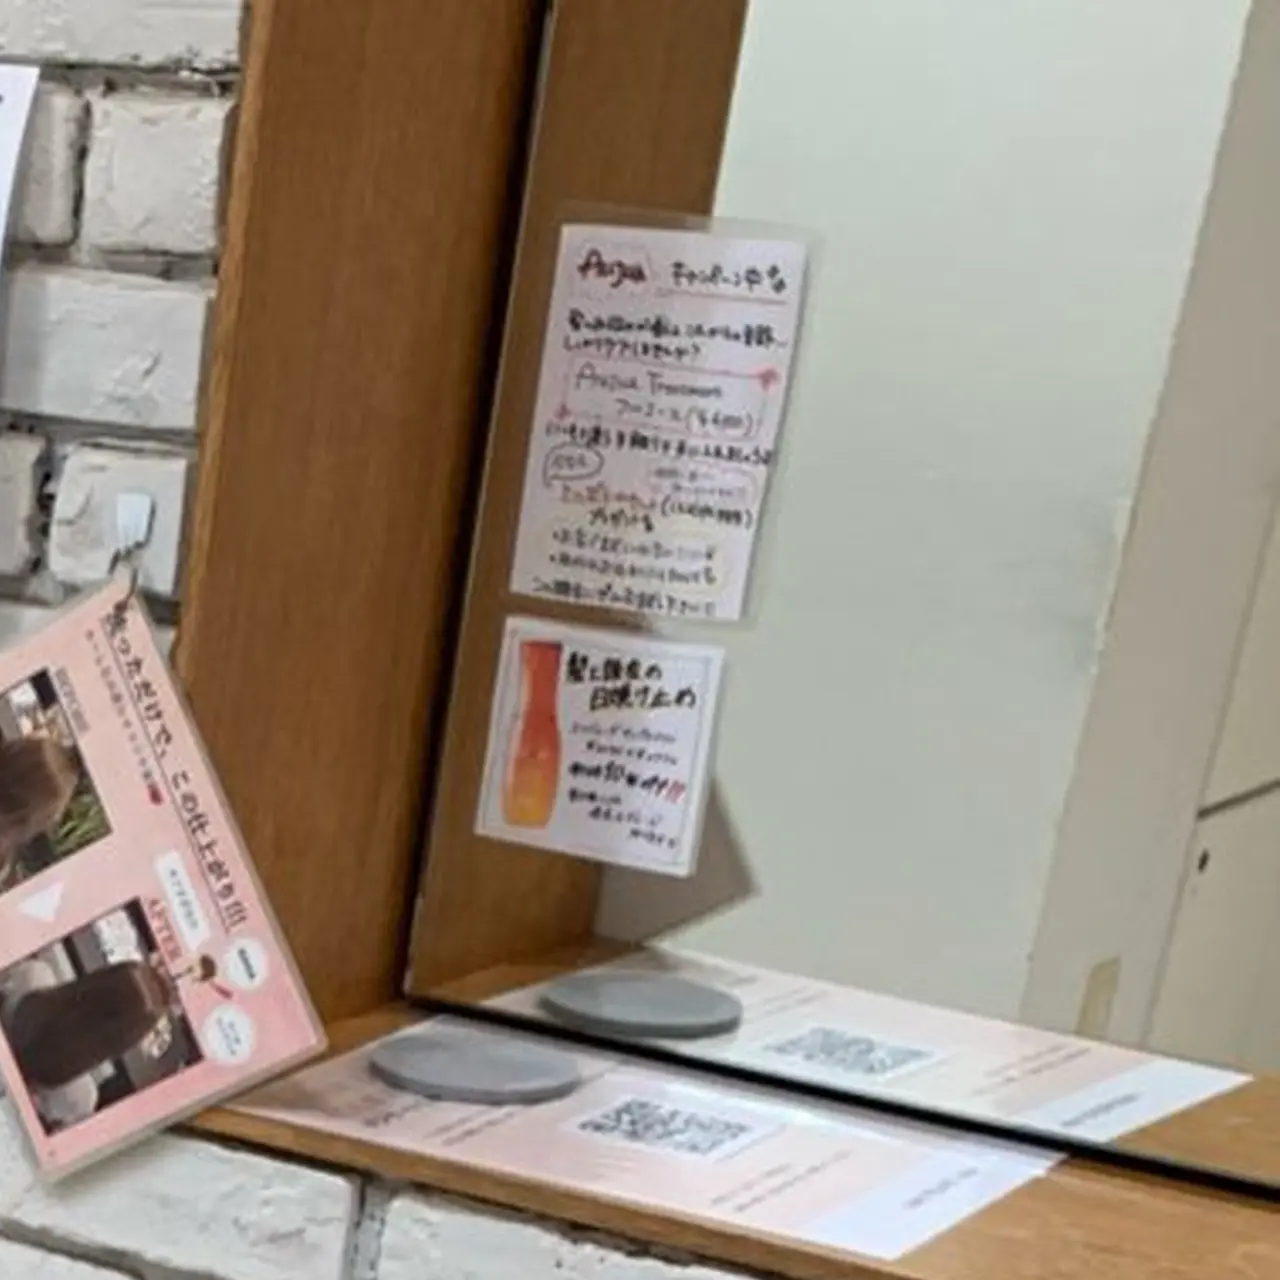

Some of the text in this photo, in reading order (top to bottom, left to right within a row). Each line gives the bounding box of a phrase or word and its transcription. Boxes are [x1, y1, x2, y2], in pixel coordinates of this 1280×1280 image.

[589, 682, 698, 712] 日焼け止め
[148, 897, 182, 961] AFTER
